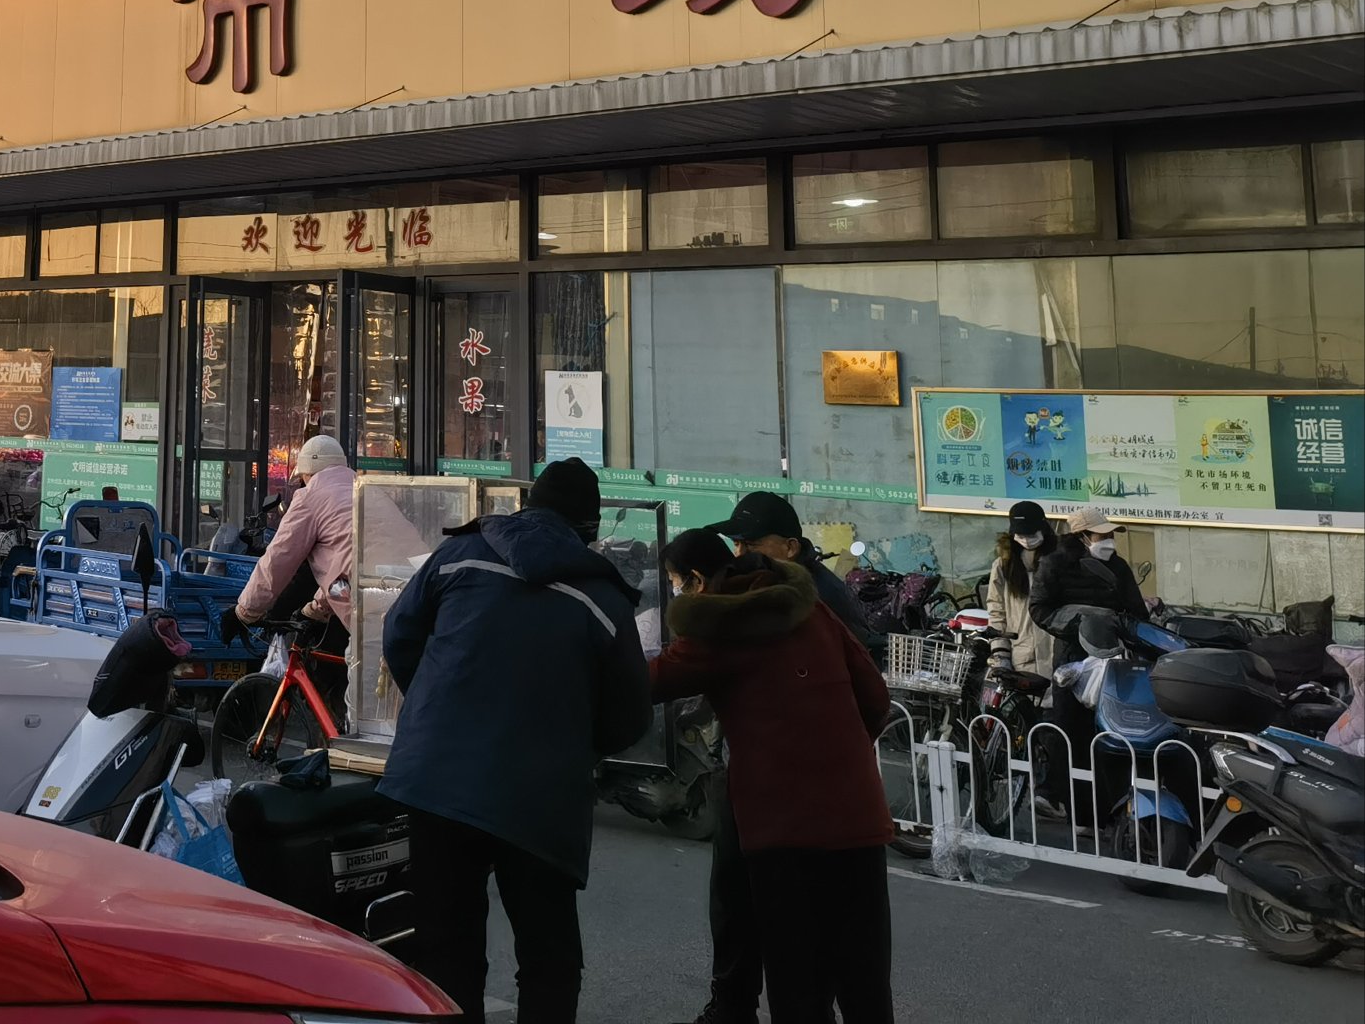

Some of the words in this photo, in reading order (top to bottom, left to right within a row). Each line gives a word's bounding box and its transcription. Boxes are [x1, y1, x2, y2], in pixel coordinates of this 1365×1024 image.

[241, 207, 433, 255] 欢迎光临
[459, 328, 491, 414] 水果
[1294, 418, 1344, 441] 诚信
[1296, 441, 1345, 465] 经营
[72, 462, 128, 475] 文明诚信经营承诺
[936, 471, 994, 487] 健康生活
[1184, 469, 1251, 480] 美化市场环境
[1025, 477, 1083, 491] 文明健康
[1199, 481, 1267, 492] 不留卫生死角
[346, 850, 388, 871] passion
[335, 871, 388, 893] SPEED
